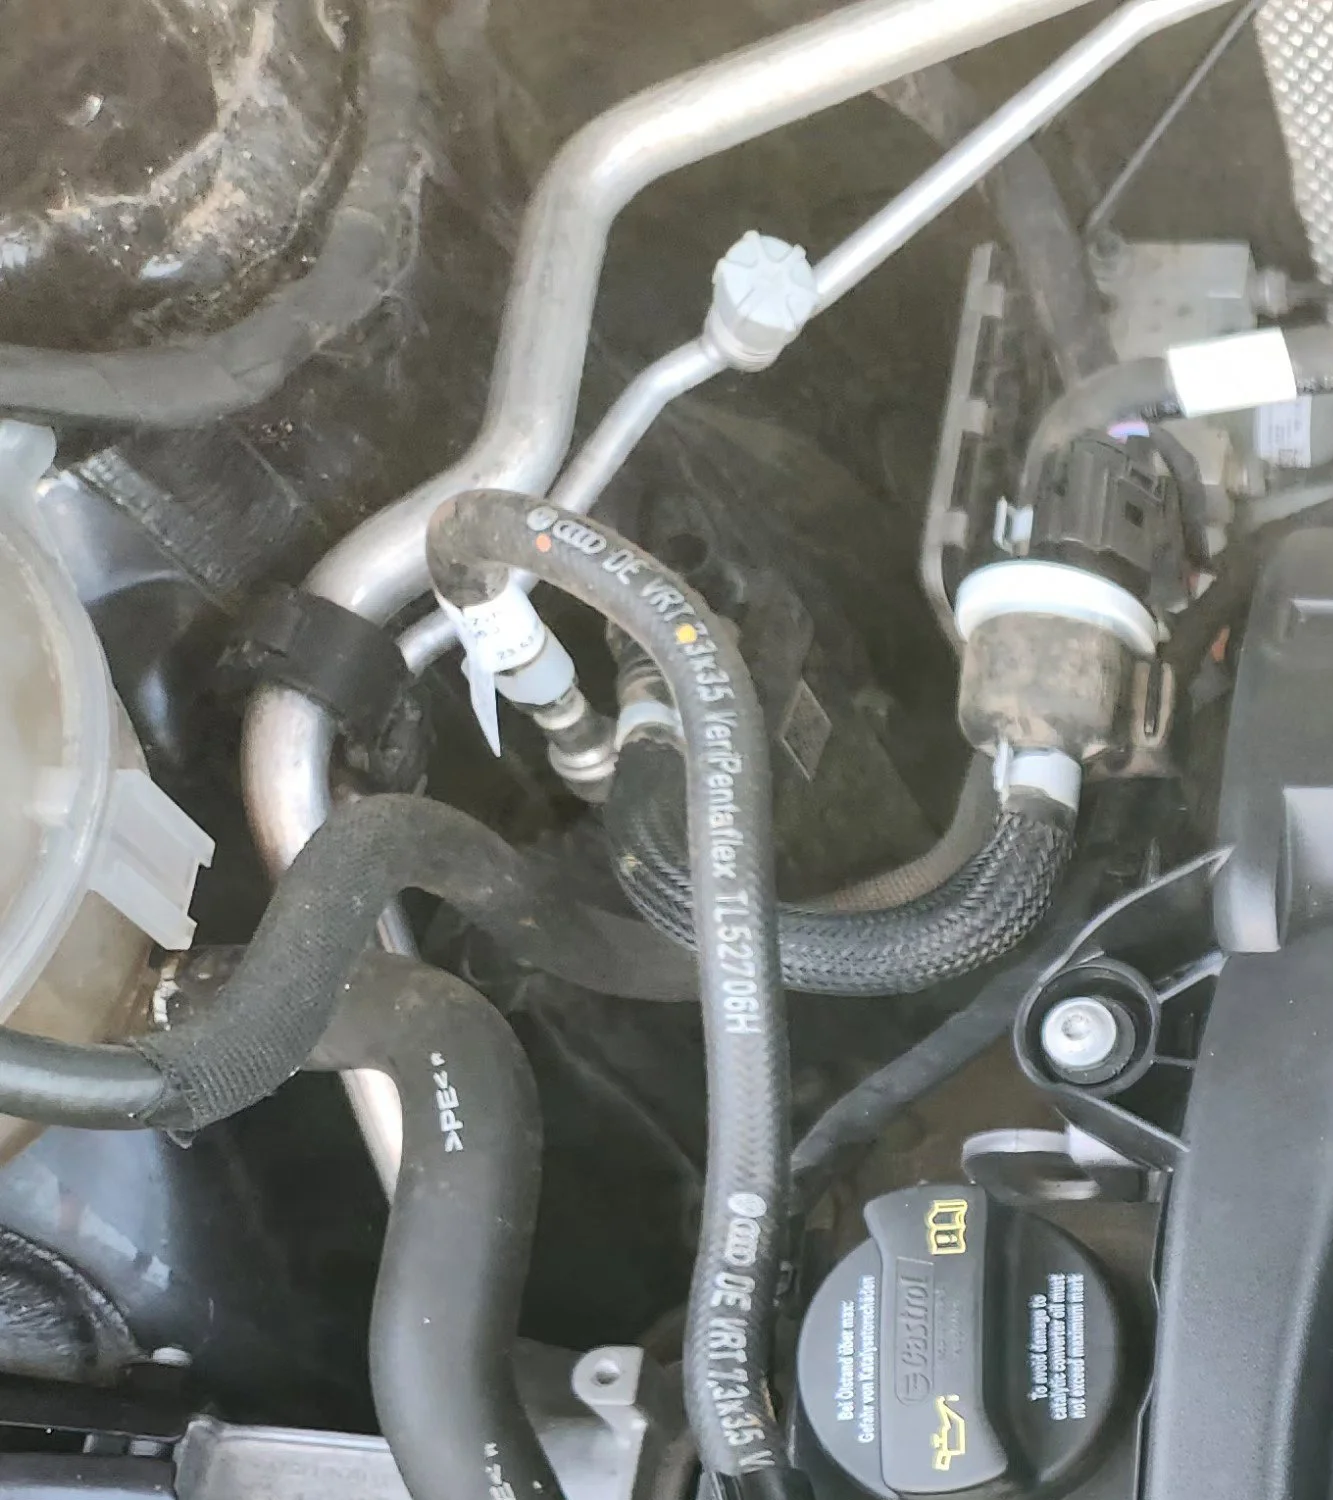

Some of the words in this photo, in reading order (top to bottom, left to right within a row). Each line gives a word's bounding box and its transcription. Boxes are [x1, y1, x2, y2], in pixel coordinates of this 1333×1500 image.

[711, 1272, 756, 1308] DE
[1031, 1295, 1047, 1308] to
[1049, 1274, 1066, 1302] must
[1069, 1274, 1084, 1301] mark
[900, 1276, 928, 1367] Castrol
[1049, 1304, 1066, 1318] oil
[706, 1317, 749, 1361] VRT
[1031, 1310, 1050, 1352] damage
[1051, 1320, 1066, 1371] converter
[1069, 1304, 1084, 1356] maximum
[836, 1357, 854, 1399] Ölstand
[1031, 1354, 1047, 1383] avoid
[1069, 1359, 1085, 1397] exceed
[839, 1402, 853, 1420] Bei
[861, 1383, 874, 1403] von
[1031, 1386, 1047, 1400] To
[1051, 1373, 1068, 1420] catalytic
[1069, 1398, 1086, 1418] not
[858, 1405, 874, 1442] Gefahr
